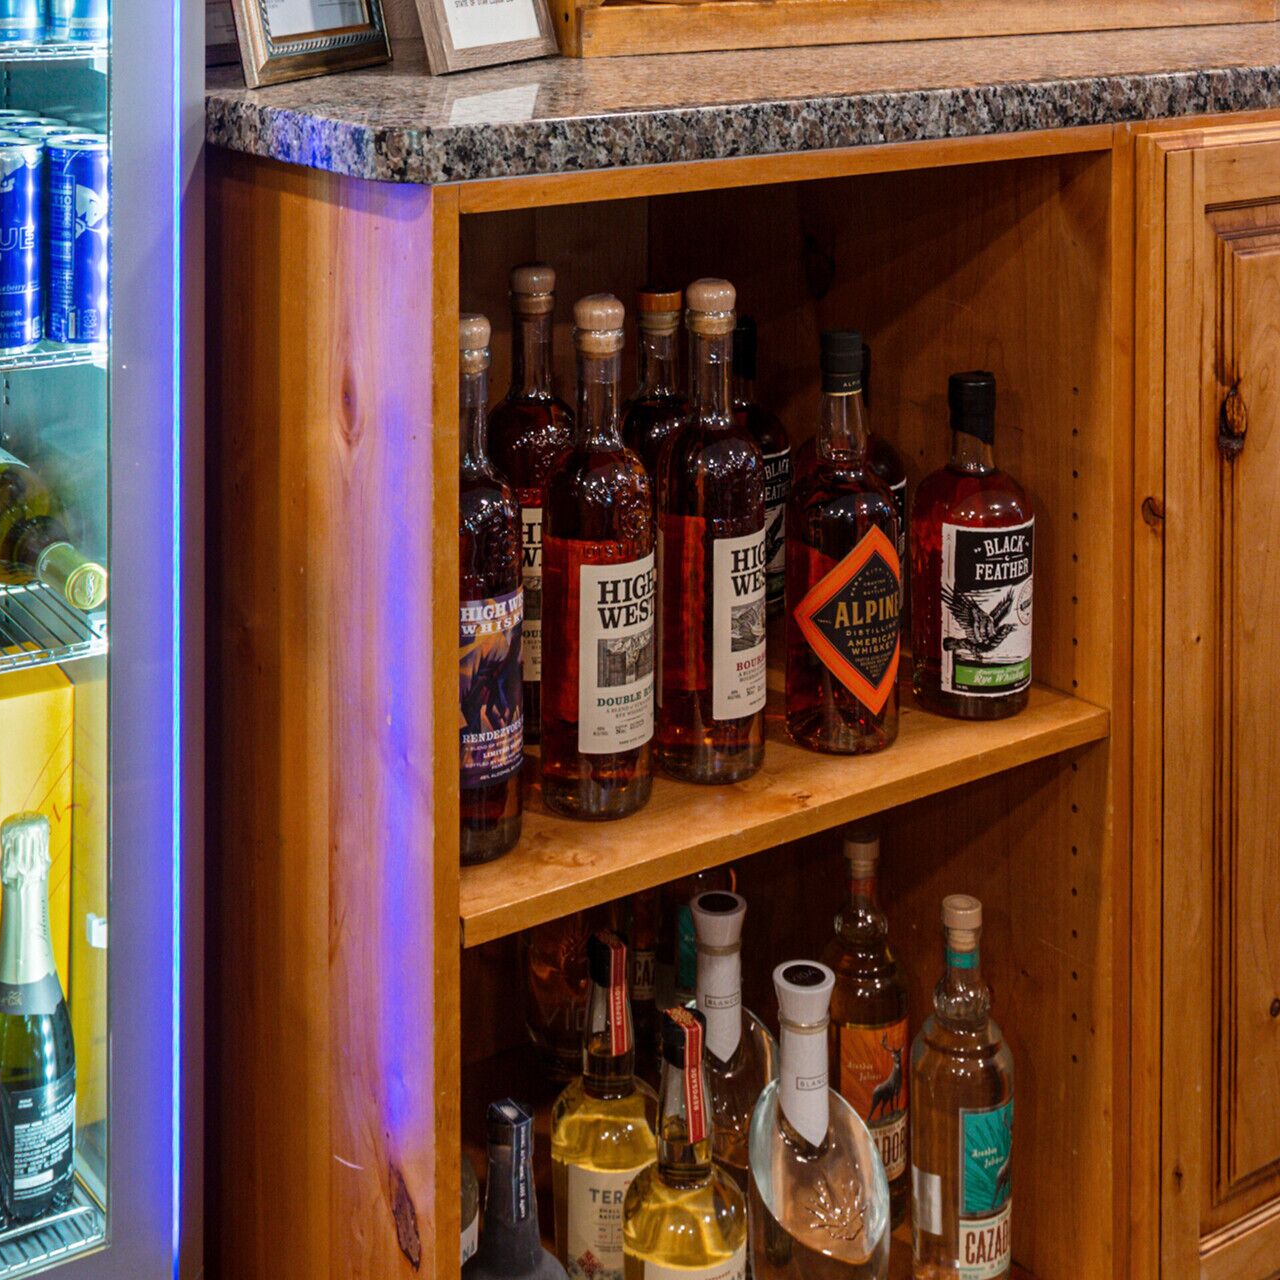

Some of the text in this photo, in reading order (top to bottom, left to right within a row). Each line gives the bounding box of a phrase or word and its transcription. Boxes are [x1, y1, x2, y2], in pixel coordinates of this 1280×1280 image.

[984, 535, 1025, 557] BLACK
[975, 558, 1029, 581] FEATHER
[460, 600, 507, 622] HIGH
[973, 674, 992, 685] Rye
[597, 692, 642, 707] DOUBLE
[691, 1067, 699, 1111] REPOSADO
